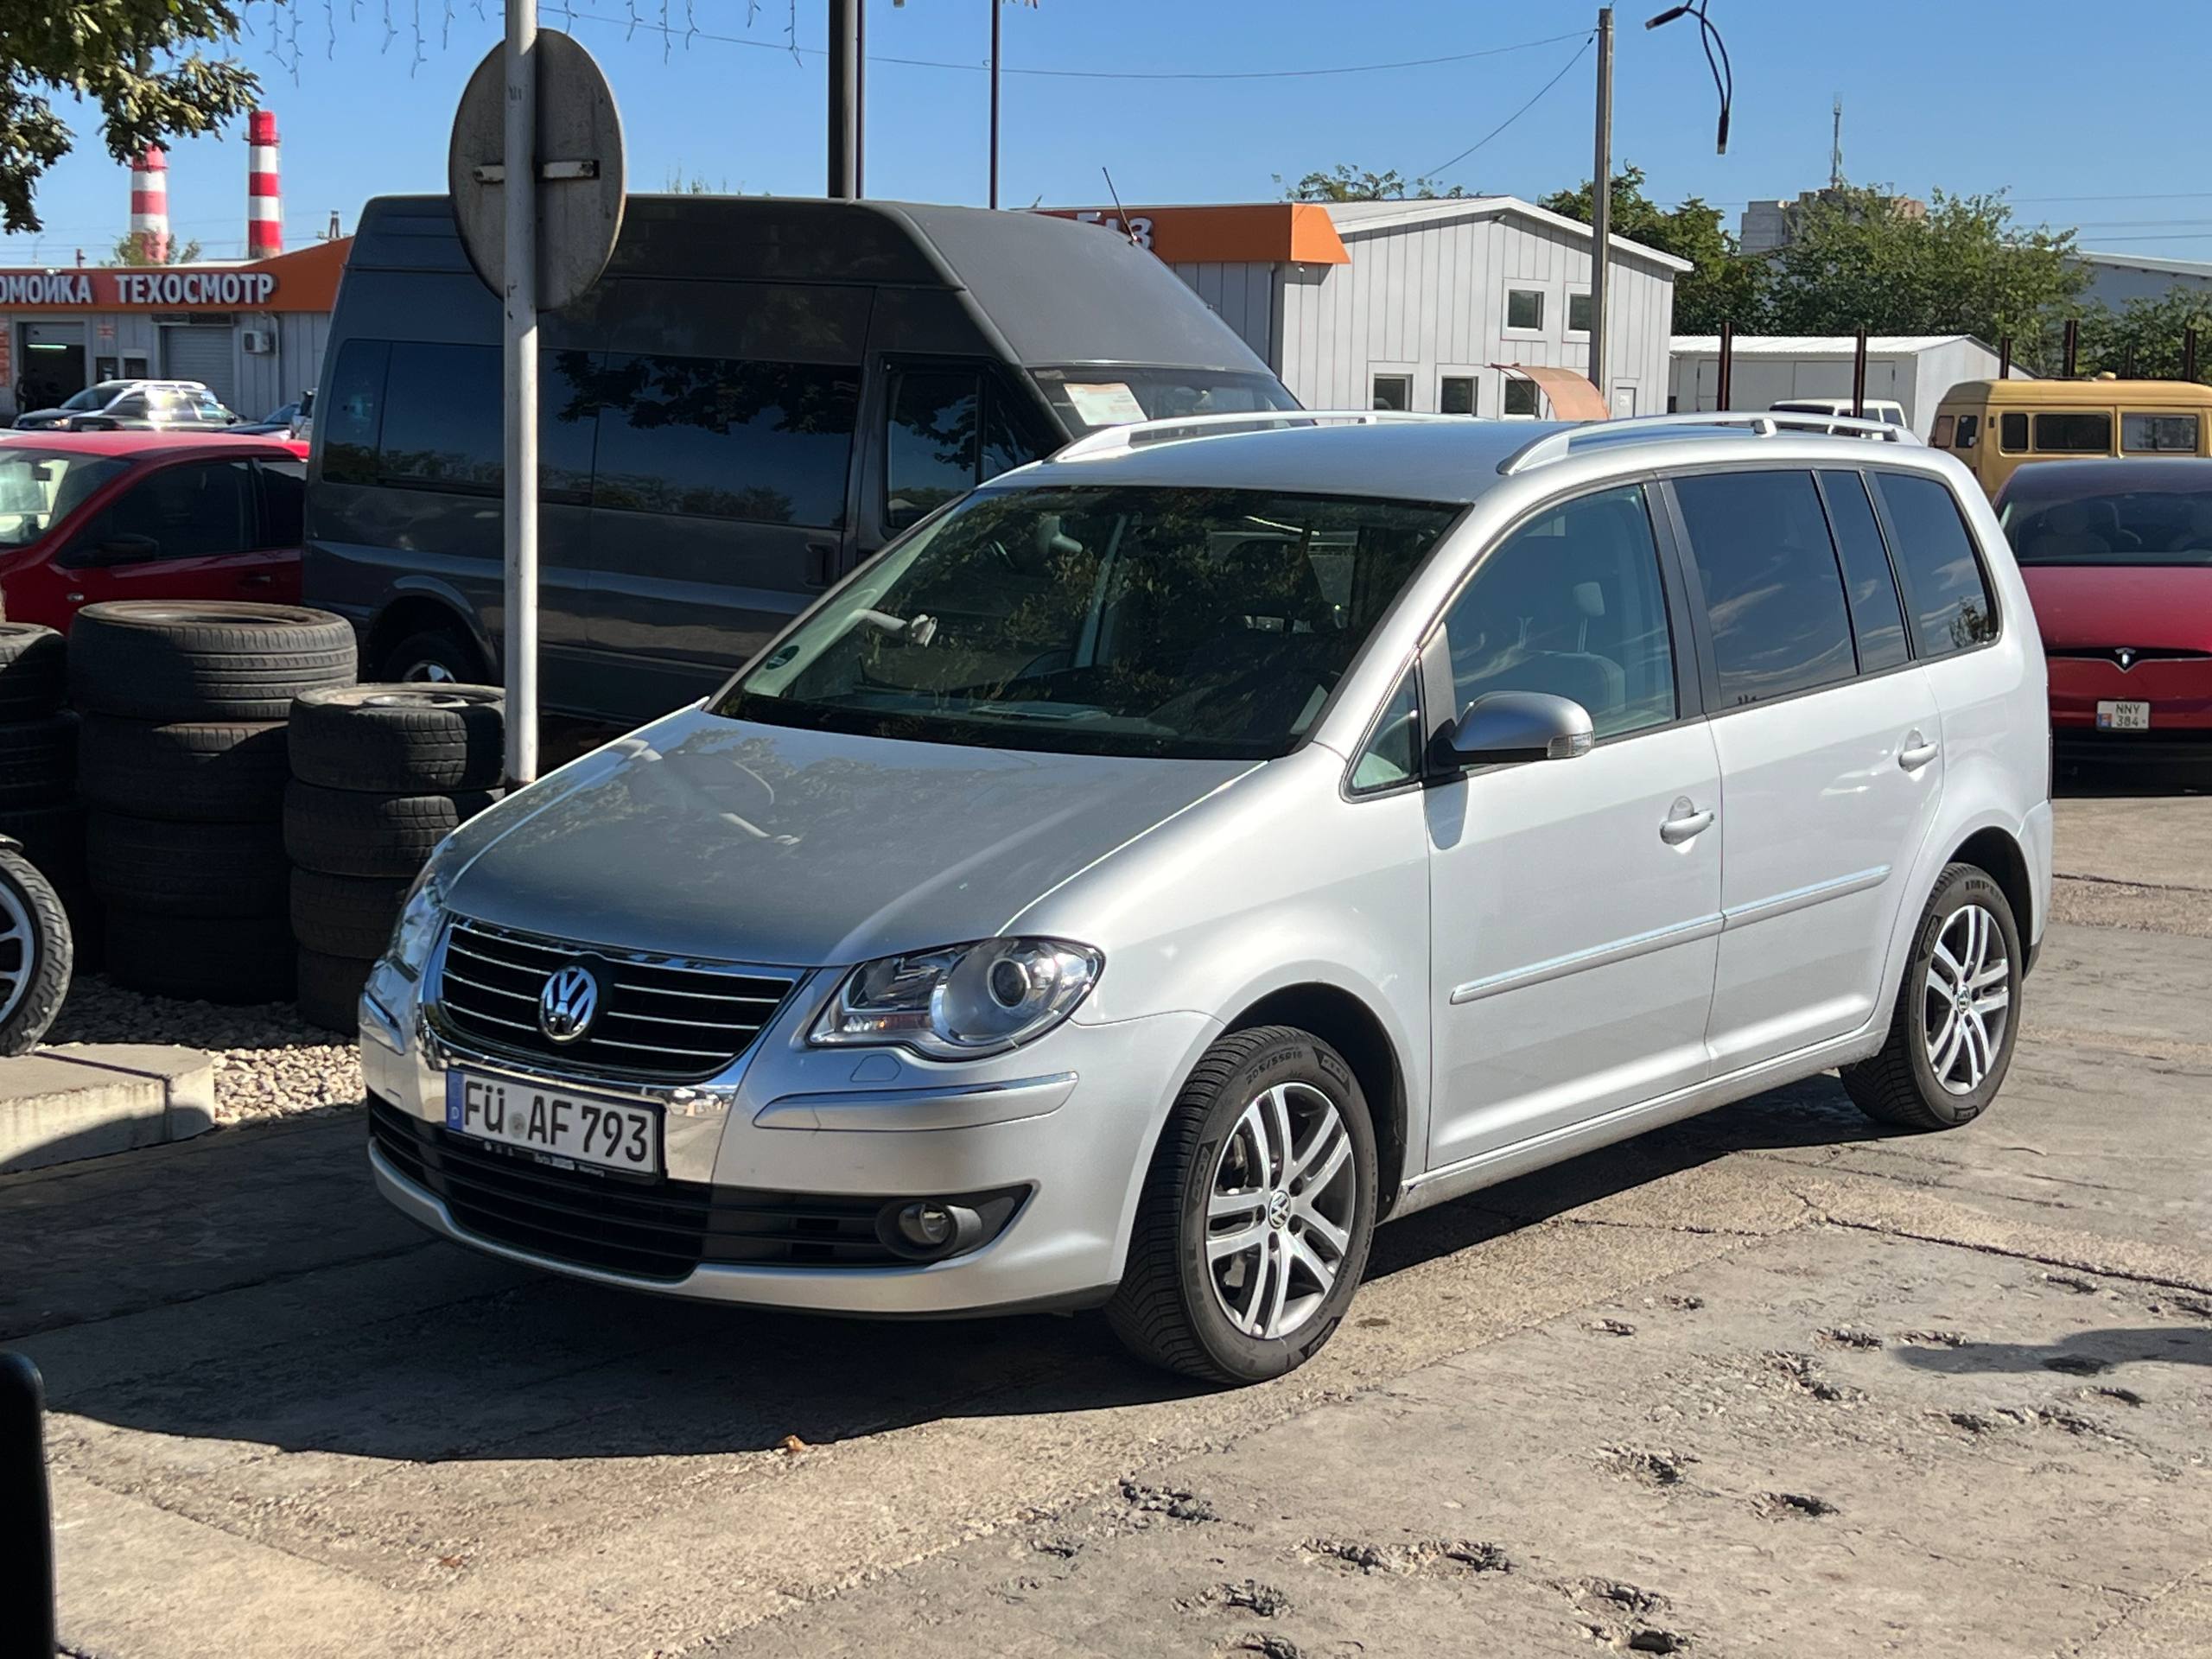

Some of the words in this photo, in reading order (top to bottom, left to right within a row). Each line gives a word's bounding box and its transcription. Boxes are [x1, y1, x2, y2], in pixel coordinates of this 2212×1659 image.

[114, 273, 274, 303] ТЕХОСМОТР
[2116, 703, 2140, 715] NNY
[540, 965, 597, 1041] VW
[449, 1106, 460, 1121] D
[465, 1080, 505, 1134] FÜ
